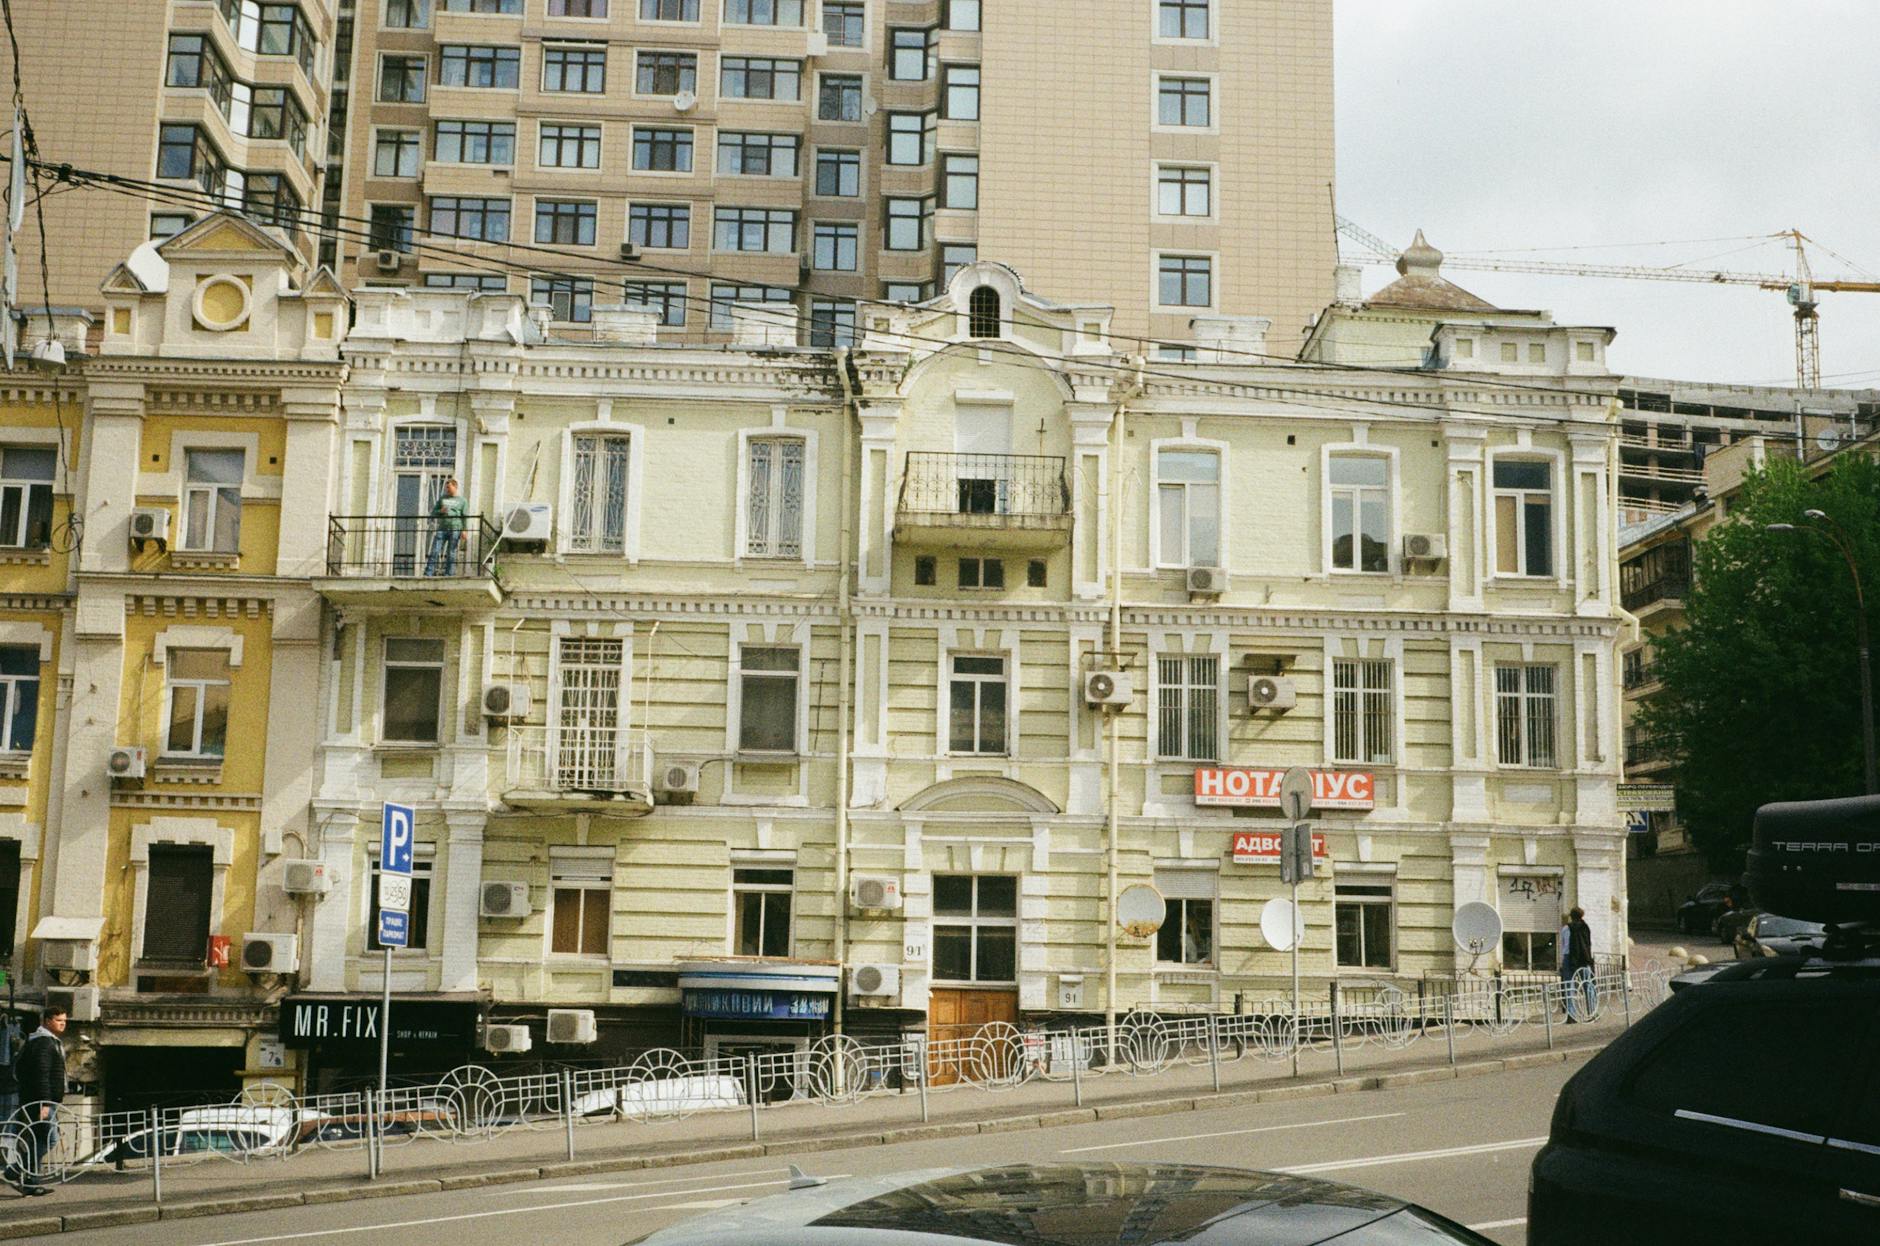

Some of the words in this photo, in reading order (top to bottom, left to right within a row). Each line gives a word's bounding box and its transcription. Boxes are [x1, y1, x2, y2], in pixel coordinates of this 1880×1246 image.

[1201, 770, 1368, 798] НОТАІУС
[390, 810, 409, 866] P
[1235, 837, 1323, 853] АДВОТ
[1772, 841, 1849, 852] TERRA
